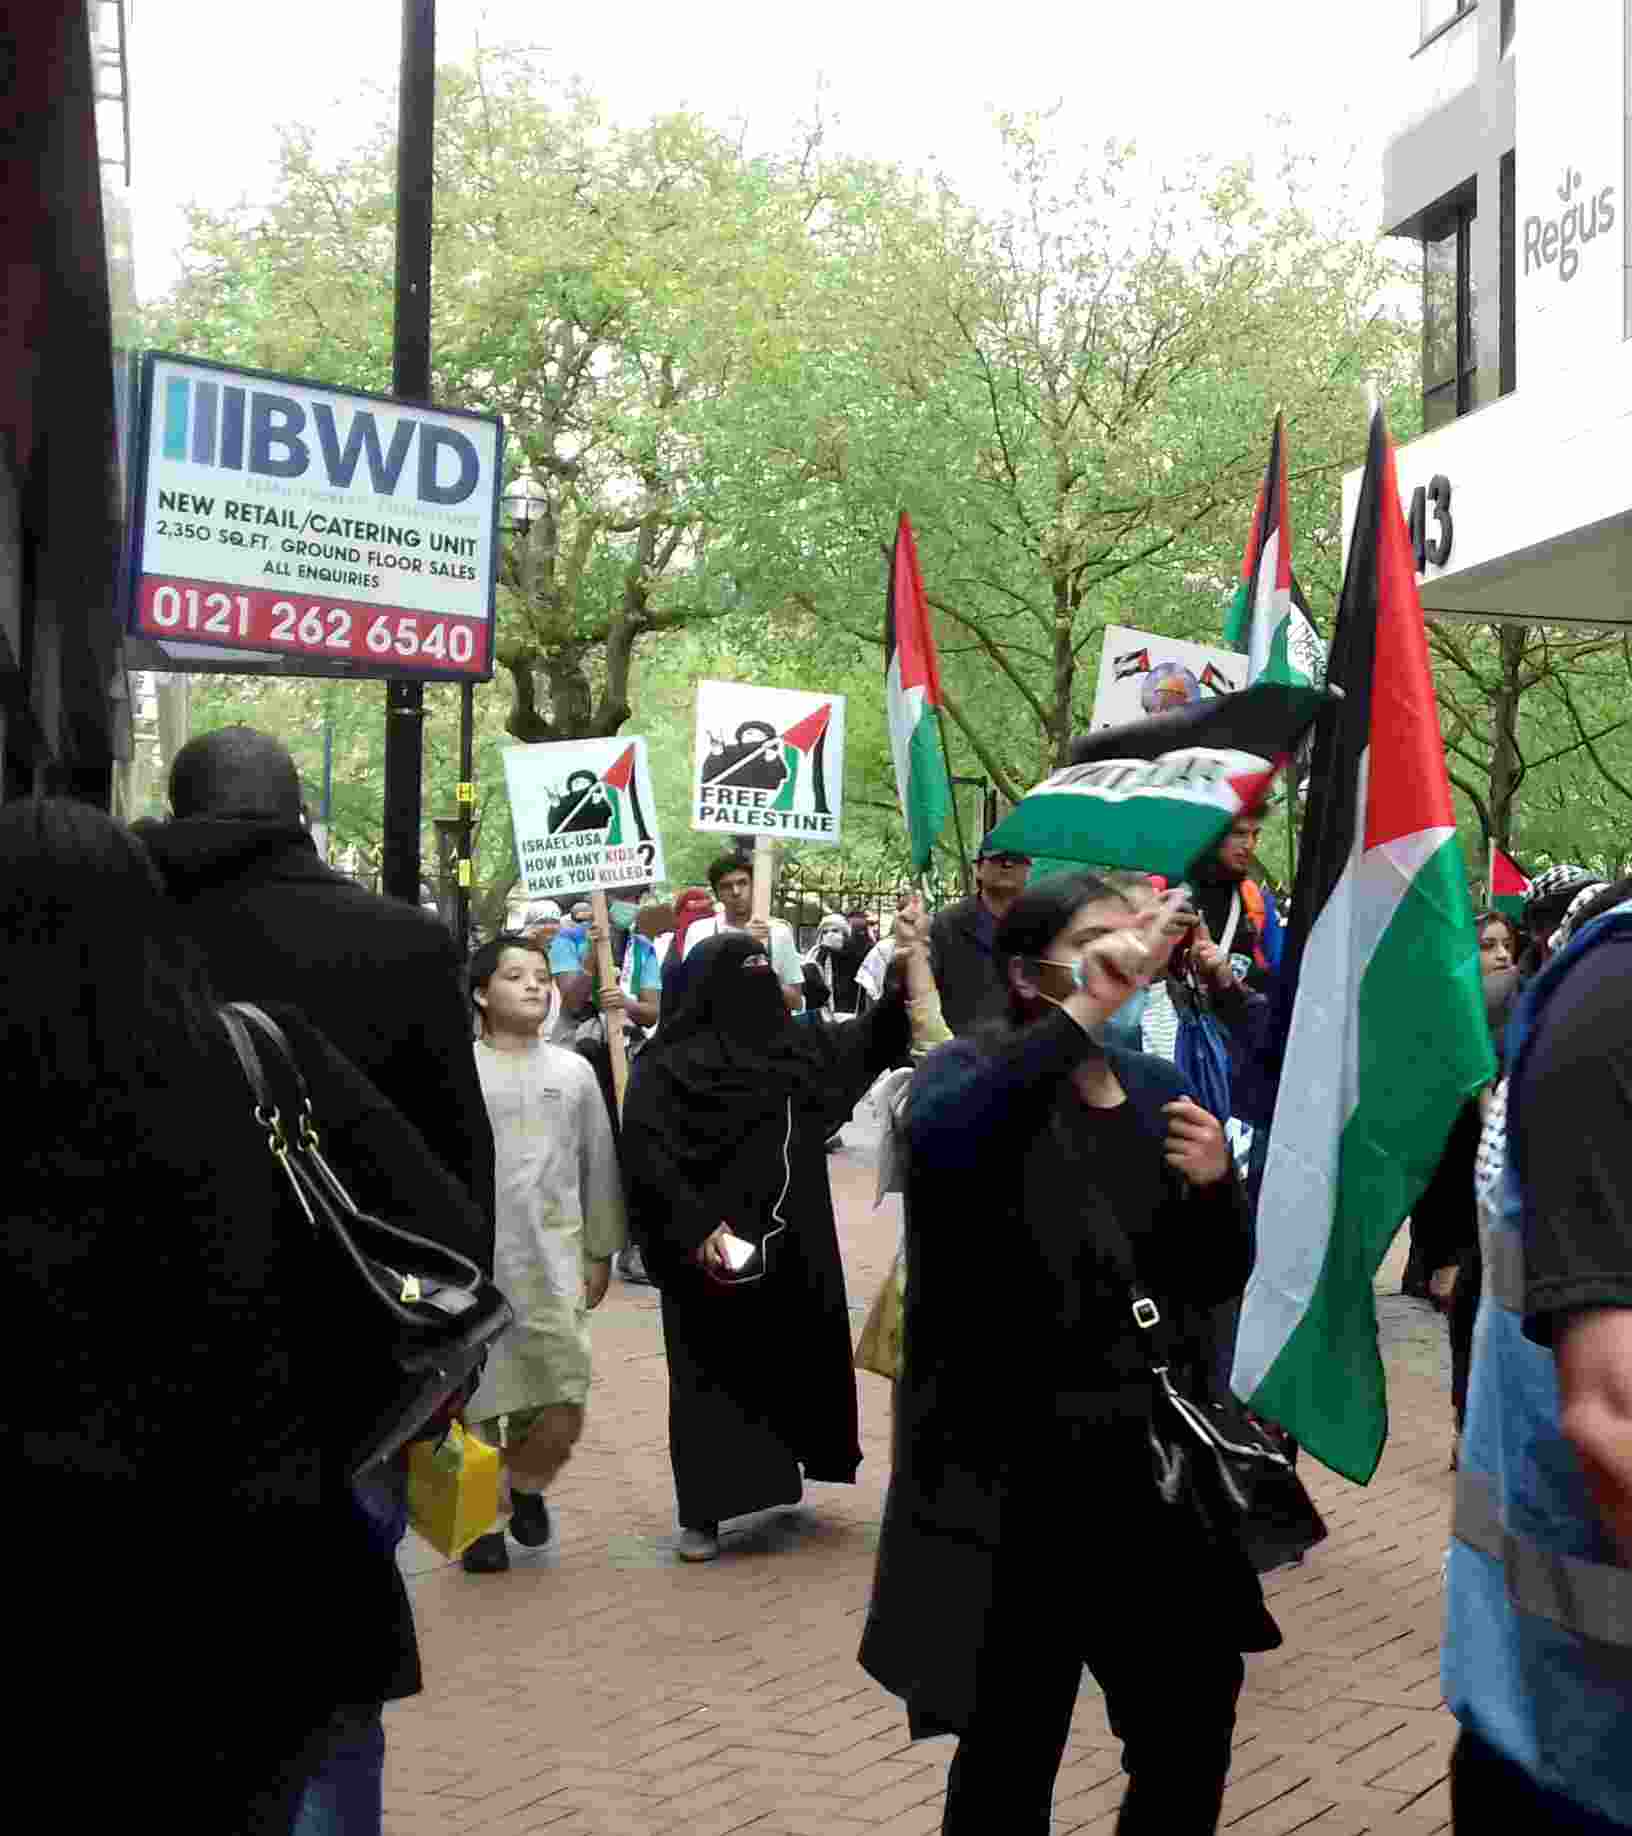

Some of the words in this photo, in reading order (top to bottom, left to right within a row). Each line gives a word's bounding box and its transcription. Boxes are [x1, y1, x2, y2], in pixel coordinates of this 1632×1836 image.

[1524, 187, 1615, 281] Regus
[249, 391, 480, 505] BWD
[158, 490, 215, 517] NEW
[224, 500, 421, 548] RETAIL/CATERING
[430, 531, 478, 557] UNIT
[156, 519, 212, 542] 2,350
[280, 537, 361, 564] GROUND
[367, 551, 423, 574] FLOOR
[429, 559, 477, 581] SALES
[262, 559, 291, 577] ALL
[297, 563, 380, 589] ENQUIRIES
[152, 585, 250, 640] 0121
[270, 600, 353, 649] 262
[365, 614, 475, 664] 6540
[701, 785, 769, 808] FREE
[699, 805, 833, 832] PALESTINE
[521, 832, 602, 853] ISRAEL-USA
[526, 854, 558, 873] HOW
[562, 850, 601, 868] MANY
[527, 874, 564, 893] HAVE
[568, 867, 594, 884] YOU
